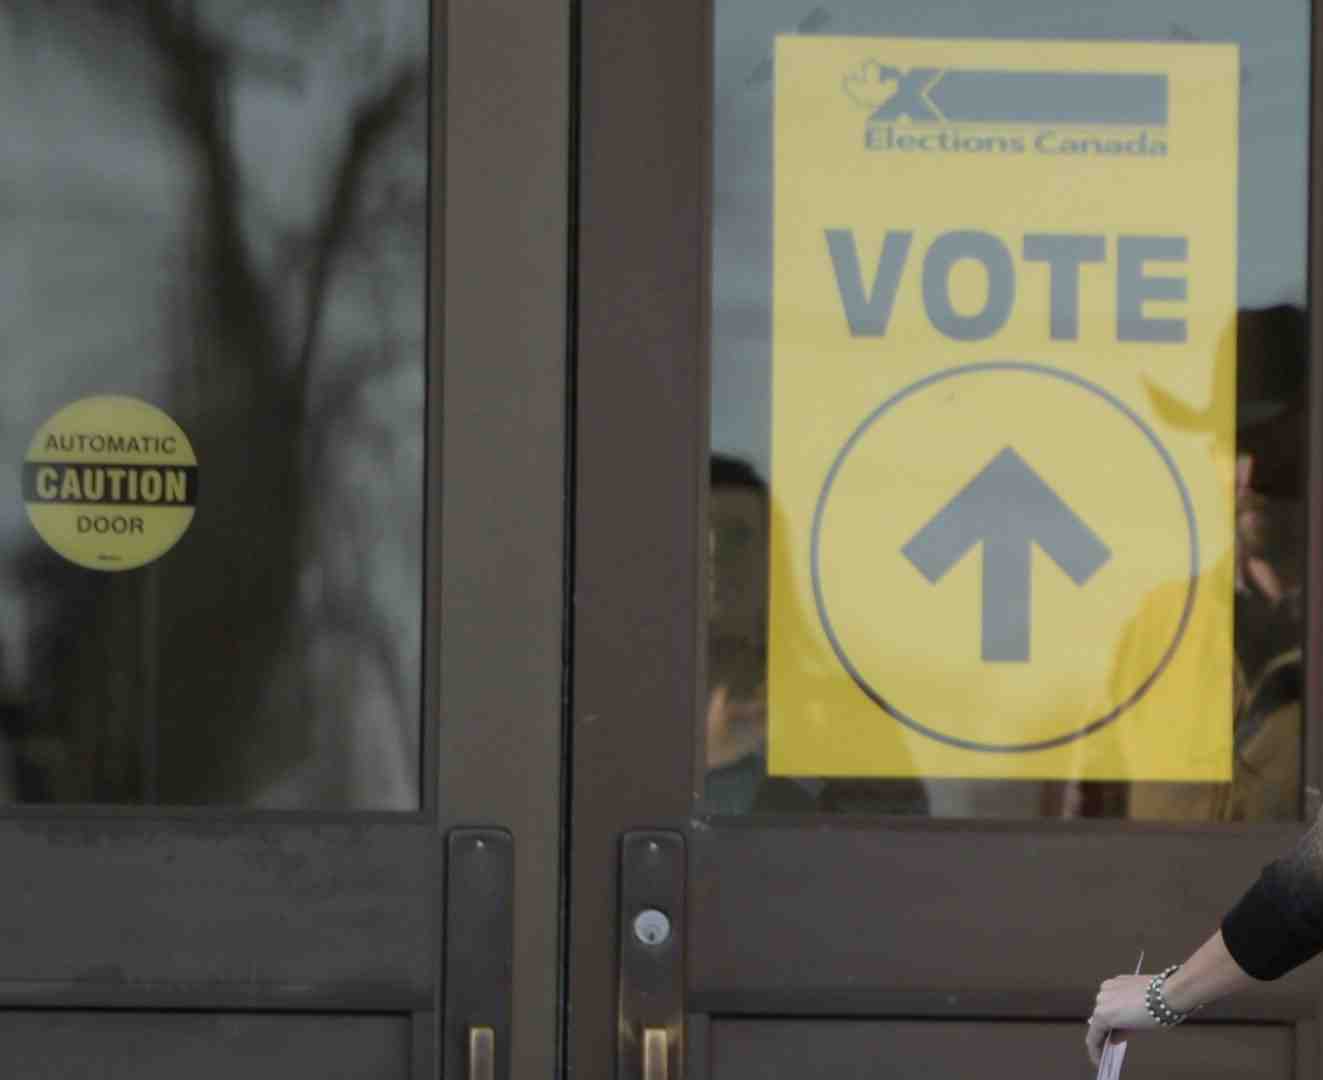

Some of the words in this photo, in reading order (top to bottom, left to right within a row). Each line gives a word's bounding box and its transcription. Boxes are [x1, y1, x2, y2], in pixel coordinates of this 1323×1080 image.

[864, 125, 1025, 153] Elections
[1034, 130, 1168, 156] Canada
[824, 228, 1189, 343] VOTE
[46, 434, 177, 454] AUTOMATIC
[35, 465, 188, 502] CAUTION
[77, 514, 145, 535] DOOR
